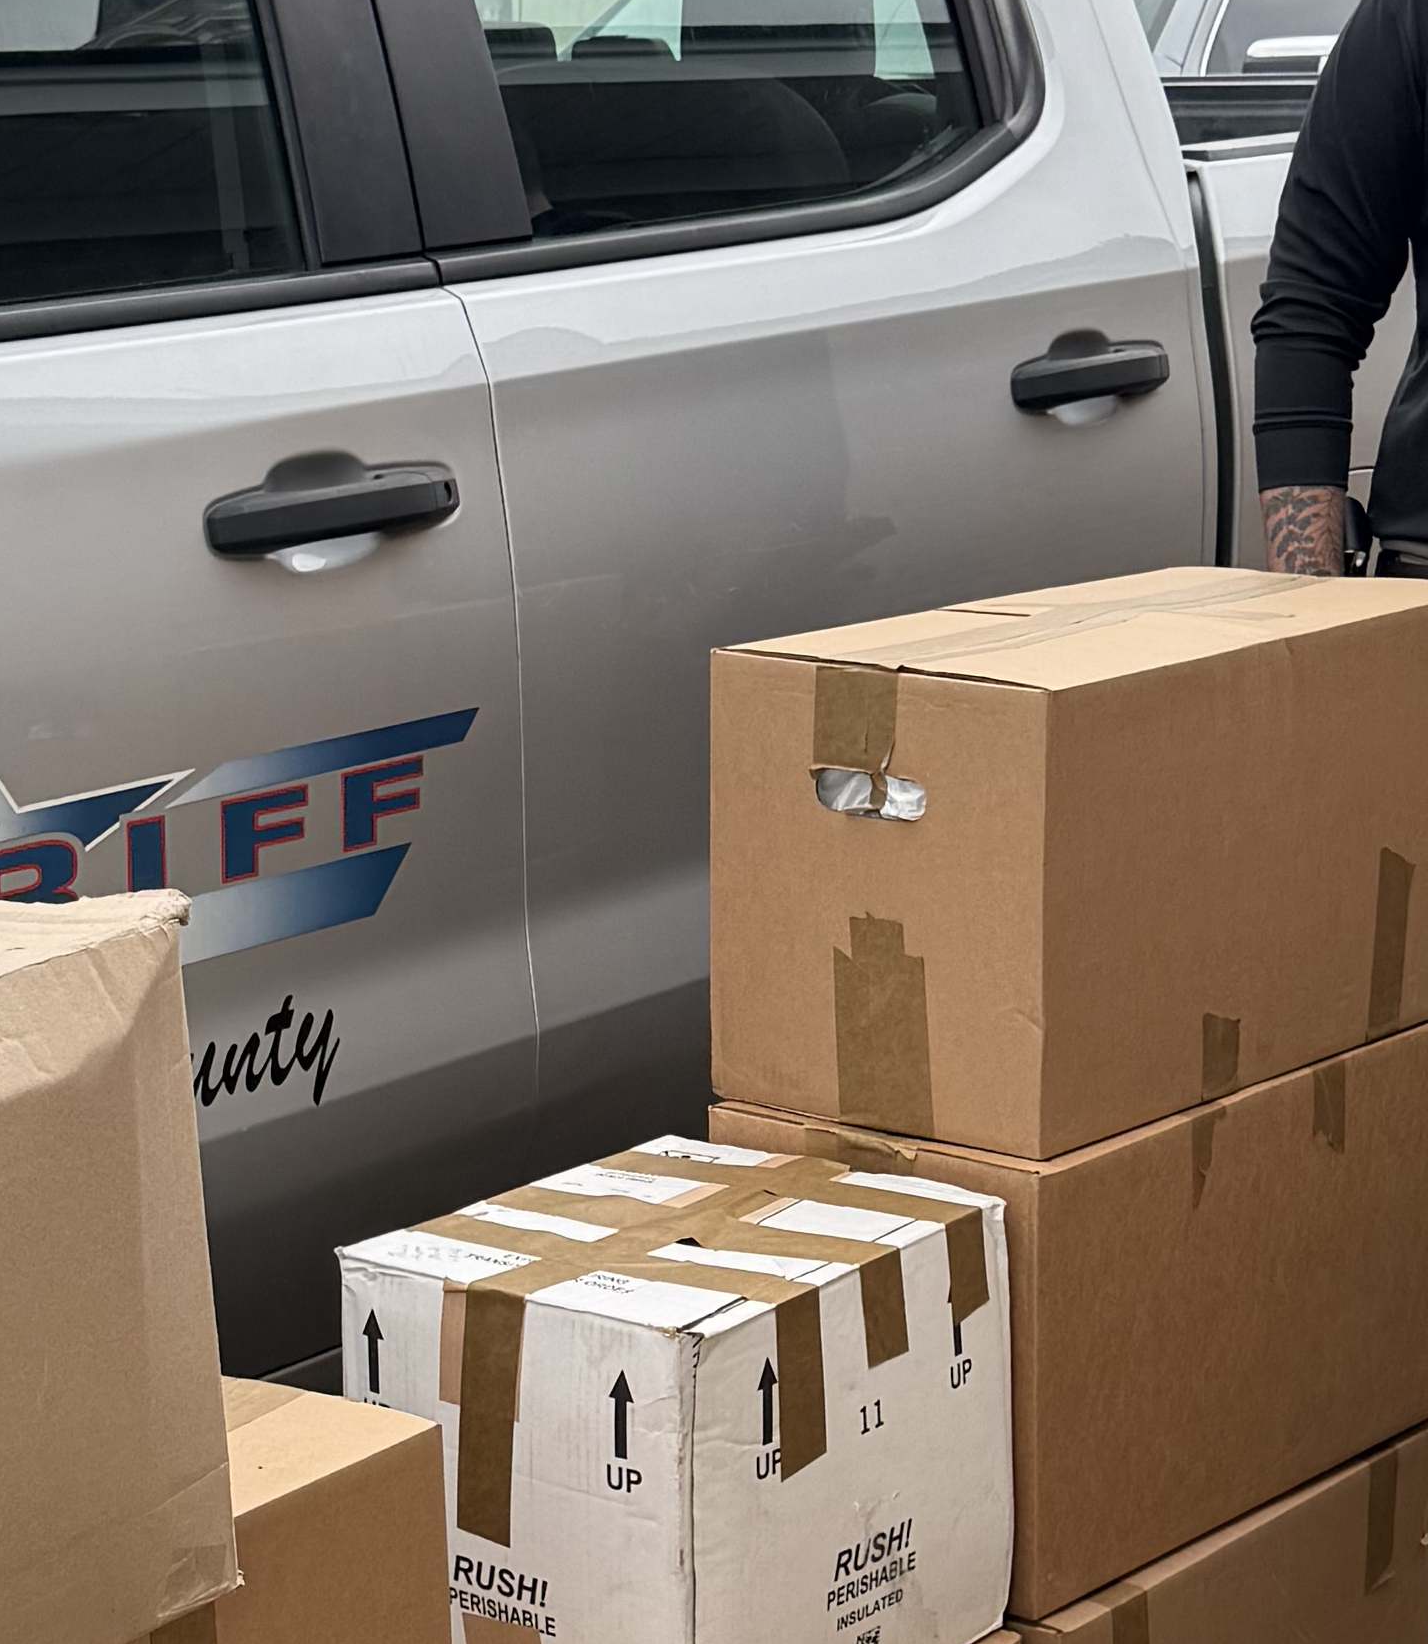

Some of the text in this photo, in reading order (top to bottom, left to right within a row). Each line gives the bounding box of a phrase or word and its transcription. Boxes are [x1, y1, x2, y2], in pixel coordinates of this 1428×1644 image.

[191, 994, 341, 1107] unty
[950, 1358, 973, 1390] UP
[859, 1398, 885, 1435] 11
[606, 1463, 643, 1493] UP
[756, 1448, 781, 1480] UP
[833, 1518, 913, 1582] RUSH!
[453, 1554, 548, 1608] RUSH!
[827, 1550, 917, 1612] PERISHABLE
[449, 1586, 557, 1637] PERISHABLE
[836, 1588, 904, 1632] INSULATED
